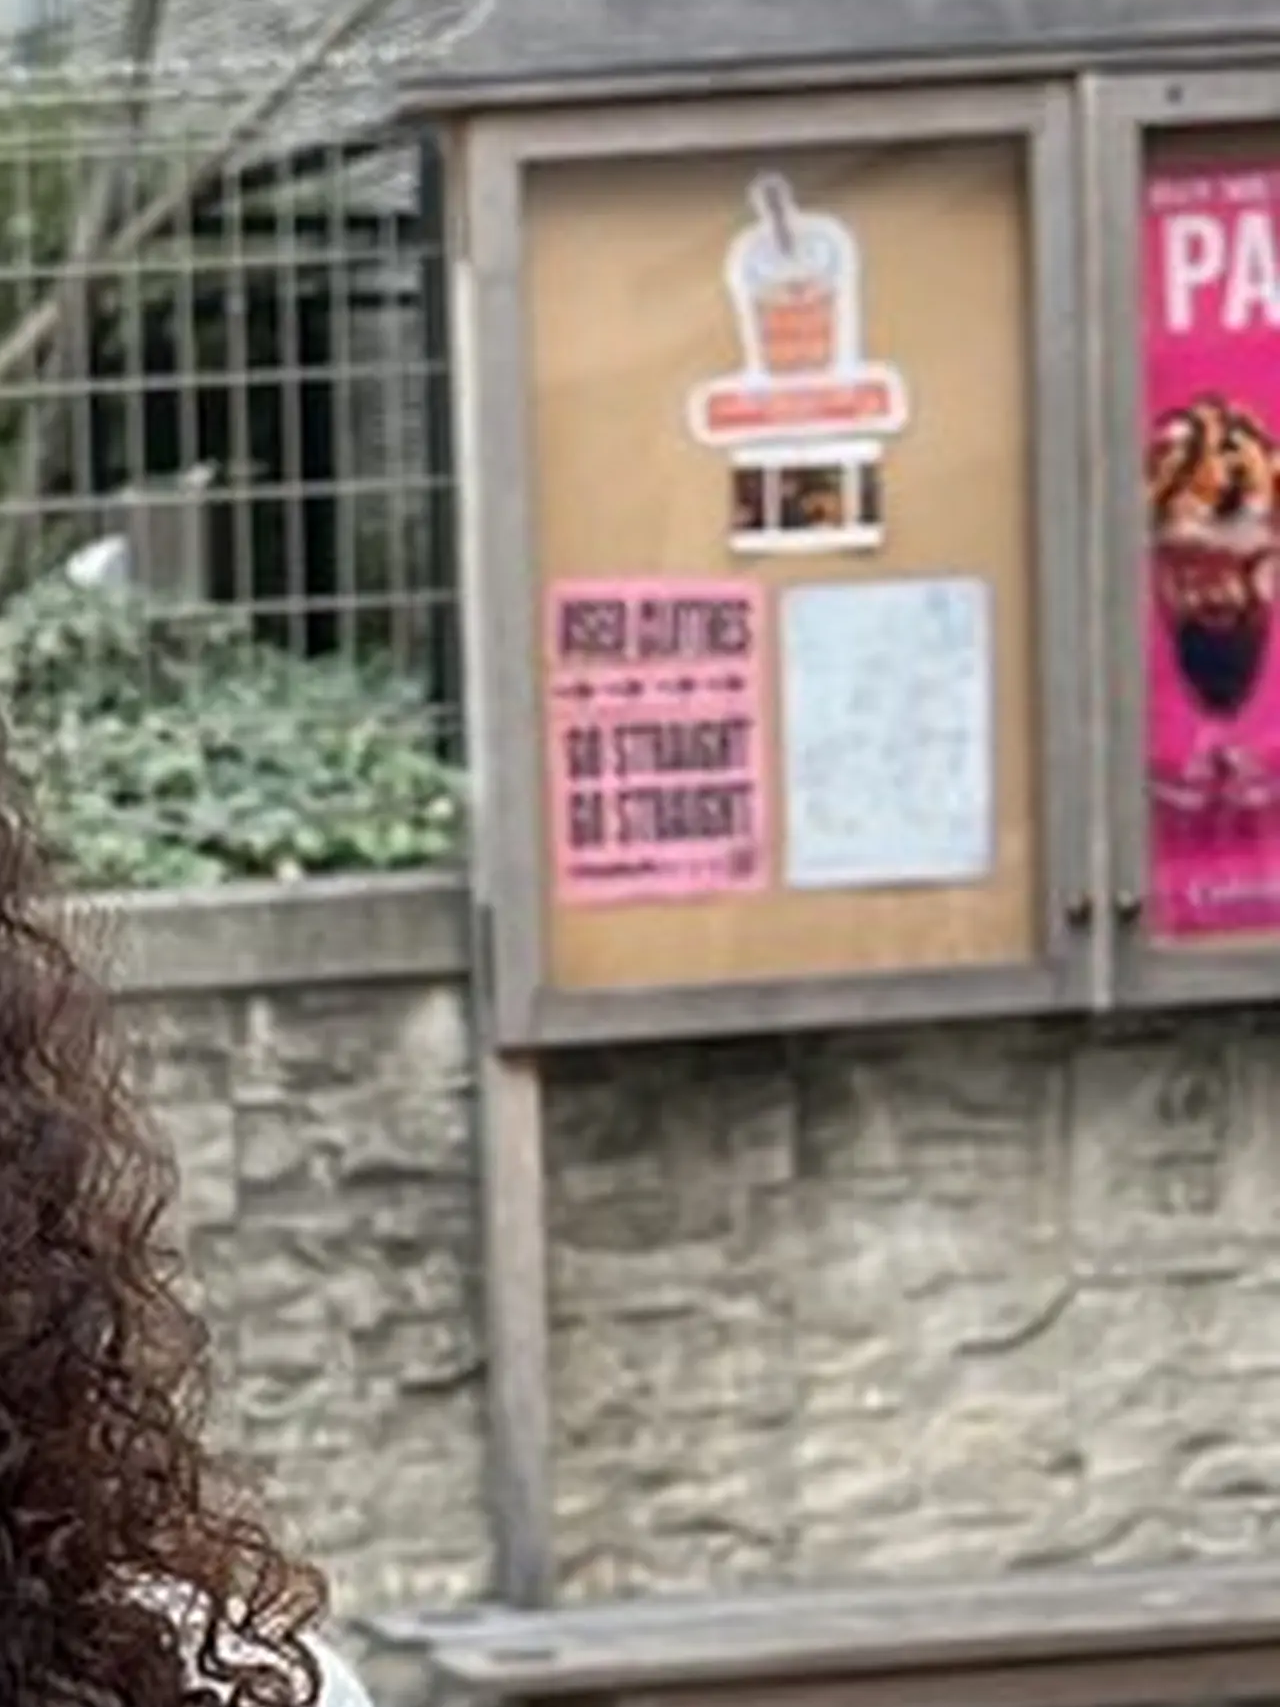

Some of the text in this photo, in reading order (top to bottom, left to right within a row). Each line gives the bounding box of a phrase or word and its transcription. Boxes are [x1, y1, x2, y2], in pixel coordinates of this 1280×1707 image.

[566, 716, 753, 780] GO STRAIGHT
[570, 781, 753, 848] GO STRAIGHT
